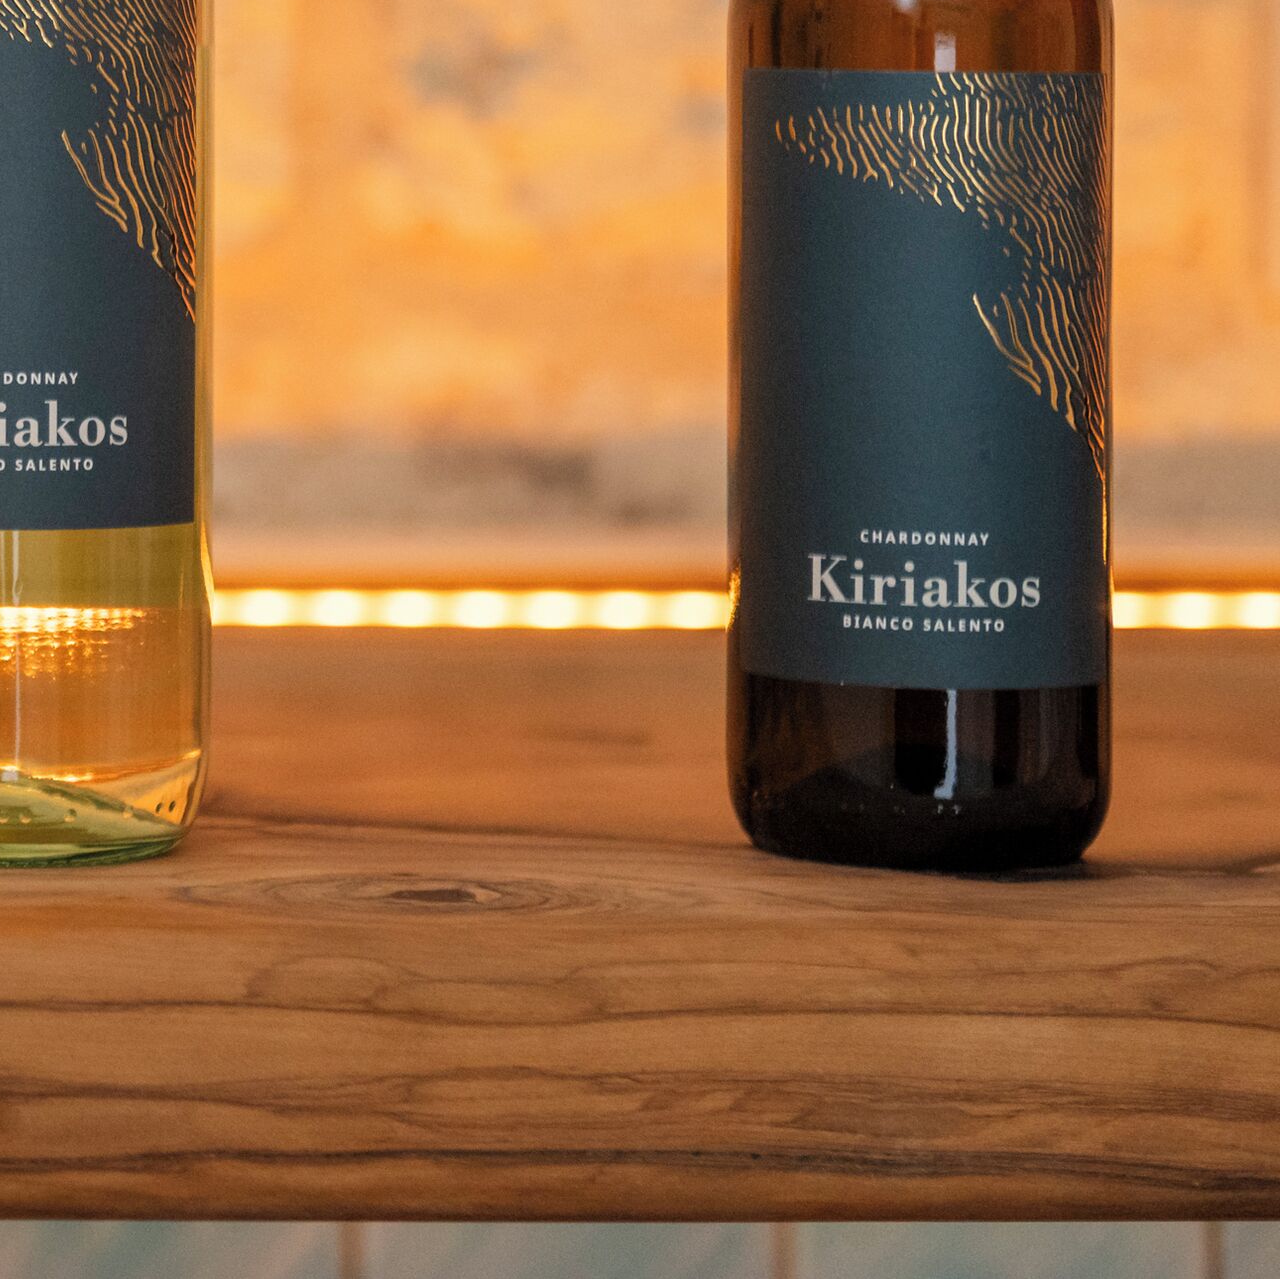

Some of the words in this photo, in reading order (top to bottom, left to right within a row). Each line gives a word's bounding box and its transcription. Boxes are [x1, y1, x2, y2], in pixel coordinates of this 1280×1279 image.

[15, 458, 94, 471] SALENTO
[860, 529, 989, 546] CHARDONNAY
[807, 553, 1040, 608] Kiriakos
[842, 614, 913, 631] BIANCO
[923, 619, 1005, 632] SALENTO
